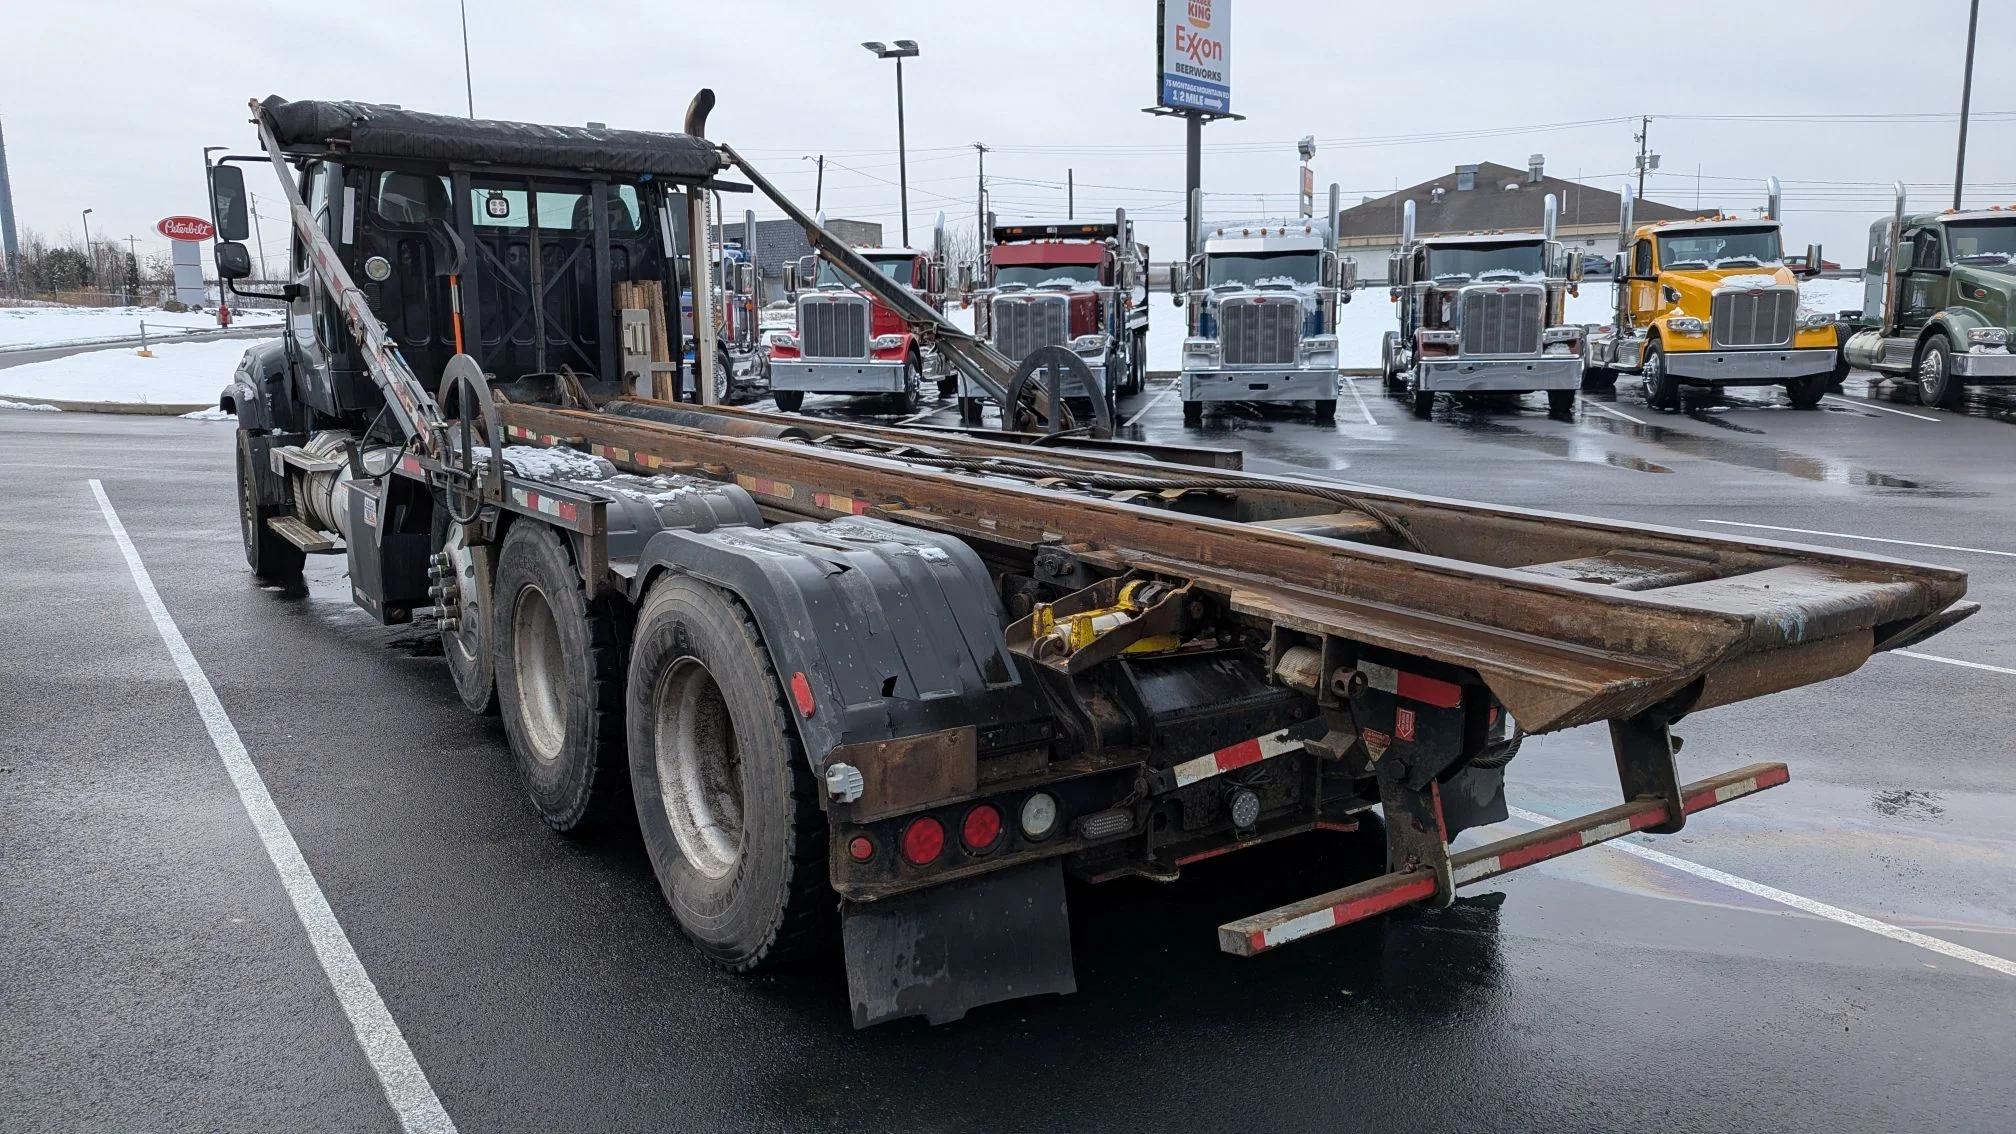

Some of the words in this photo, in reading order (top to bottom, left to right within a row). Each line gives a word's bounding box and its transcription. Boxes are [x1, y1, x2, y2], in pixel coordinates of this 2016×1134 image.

[1188, 2, 1211, 21] KING
[1176, 24, 1223, 66] Exxon
[1175, 62, 1222, 82] BEERWORKS
[1172, 80, 1197, 92] MONTAGE
[1185, 92, 1204, 106] MILE
[164, 219, 212, 236] Peterbilt
